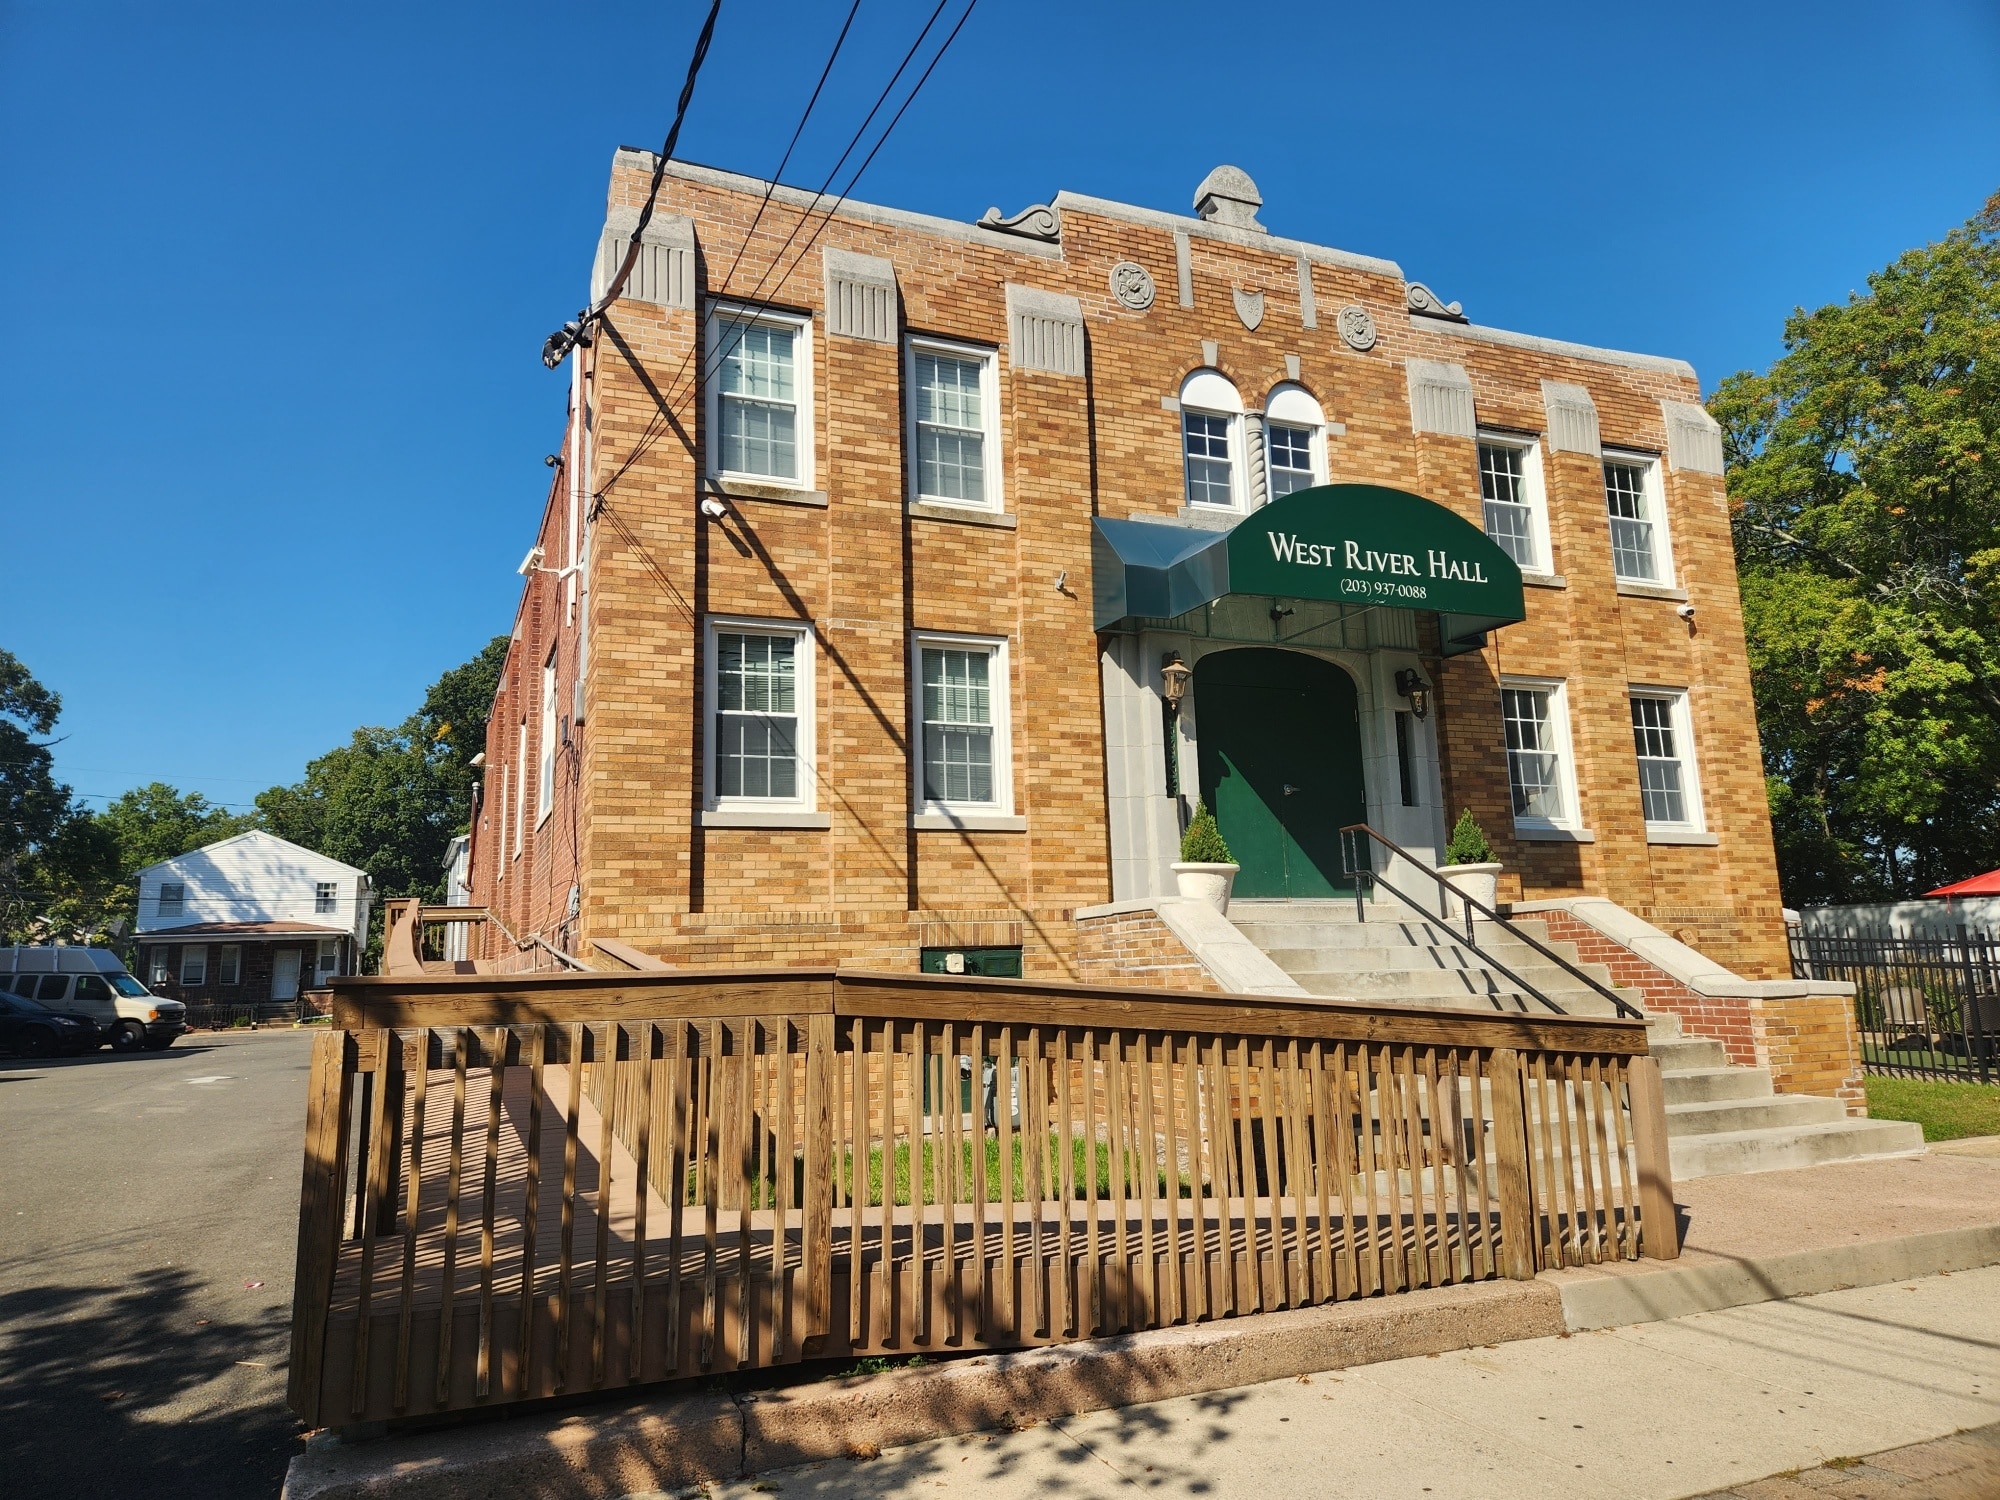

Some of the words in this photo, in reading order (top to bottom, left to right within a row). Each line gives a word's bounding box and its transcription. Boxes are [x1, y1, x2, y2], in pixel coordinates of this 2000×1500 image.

[1267, 531, 1336, 567] WEST
[1344, 540, 1421, 577] RIVER
[1427, 549, 1488, 583] HALL
[1340, 578, 1372, 597] (203)
[1374, 581, 1427, 599] 937-0088
